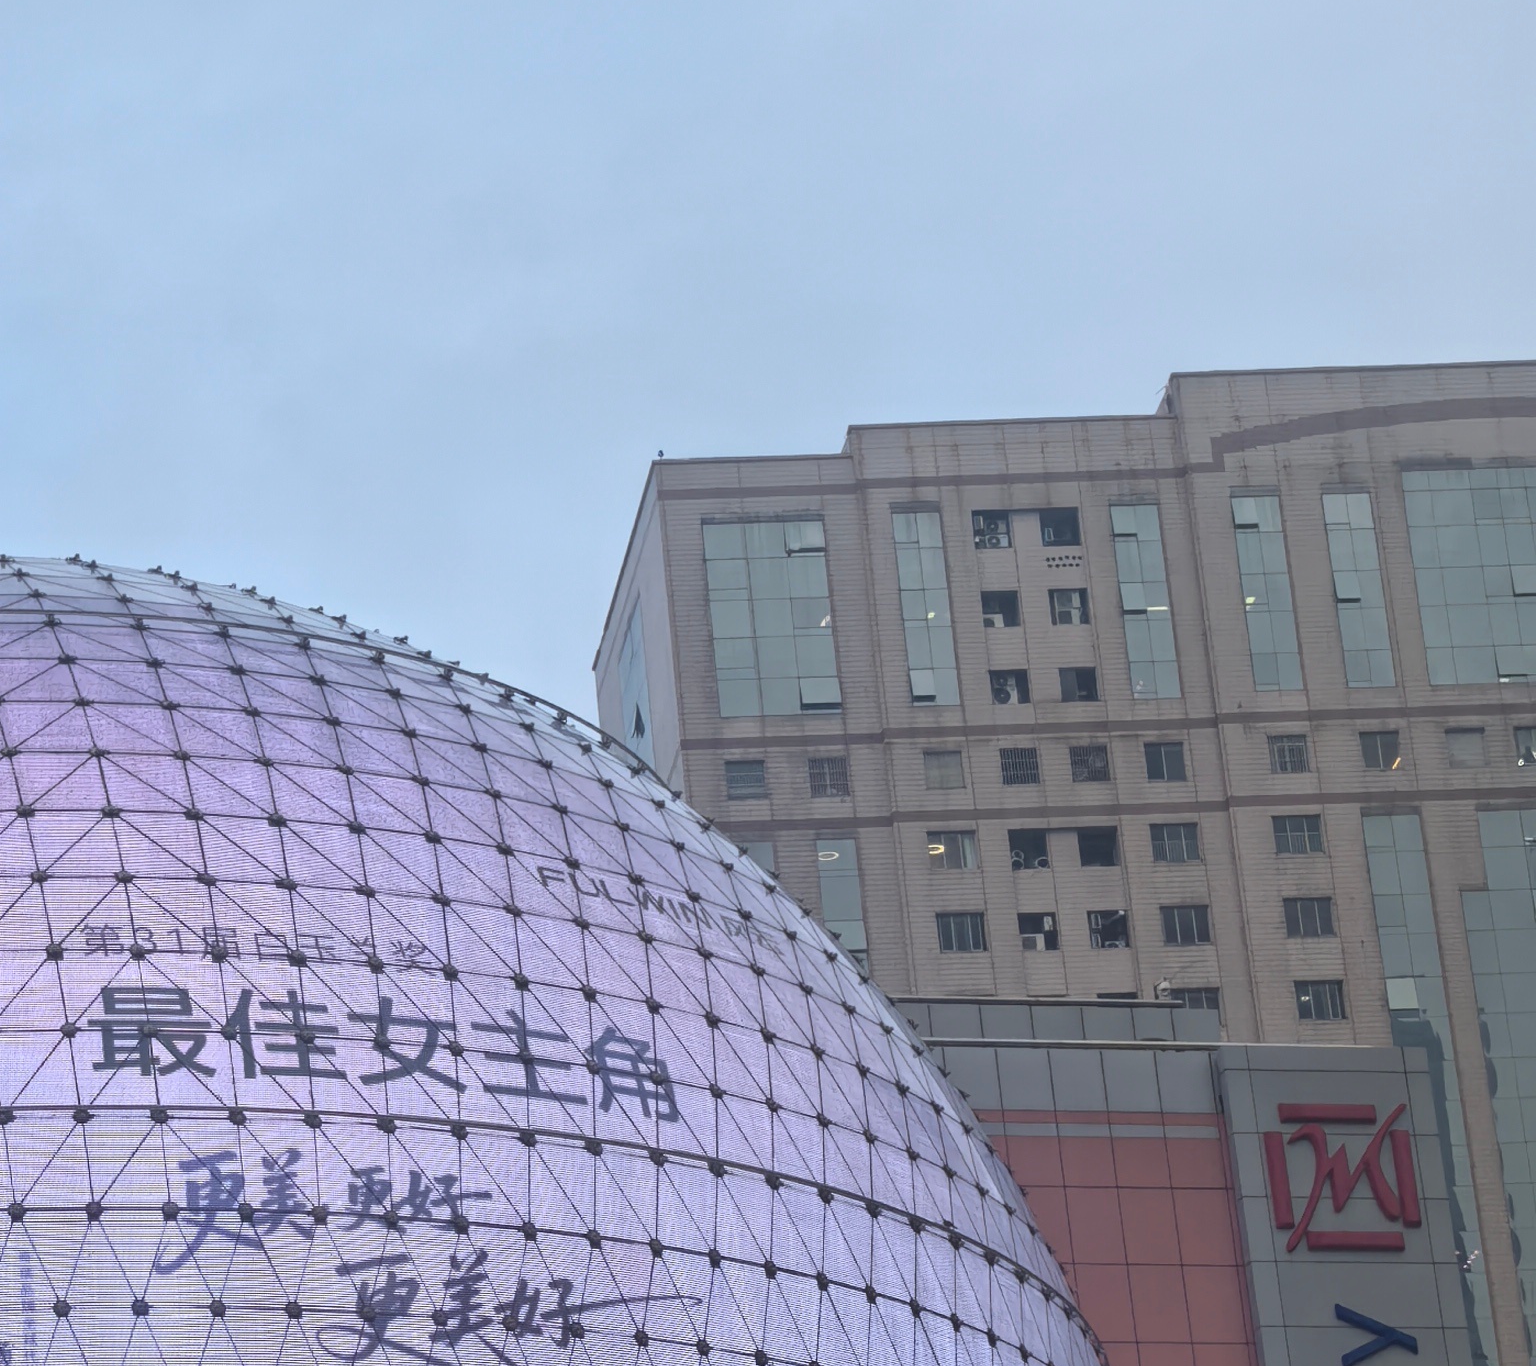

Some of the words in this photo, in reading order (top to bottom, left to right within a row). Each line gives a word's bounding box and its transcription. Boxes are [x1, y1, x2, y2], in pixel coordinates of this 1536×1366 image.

[537, 865, 713, 931] FULWIN
[88, 986, 680, 1123] 最佳女主角
[154, 1148, 315, 1275] 更美
[341, 1166, 493, 1235] 更好
